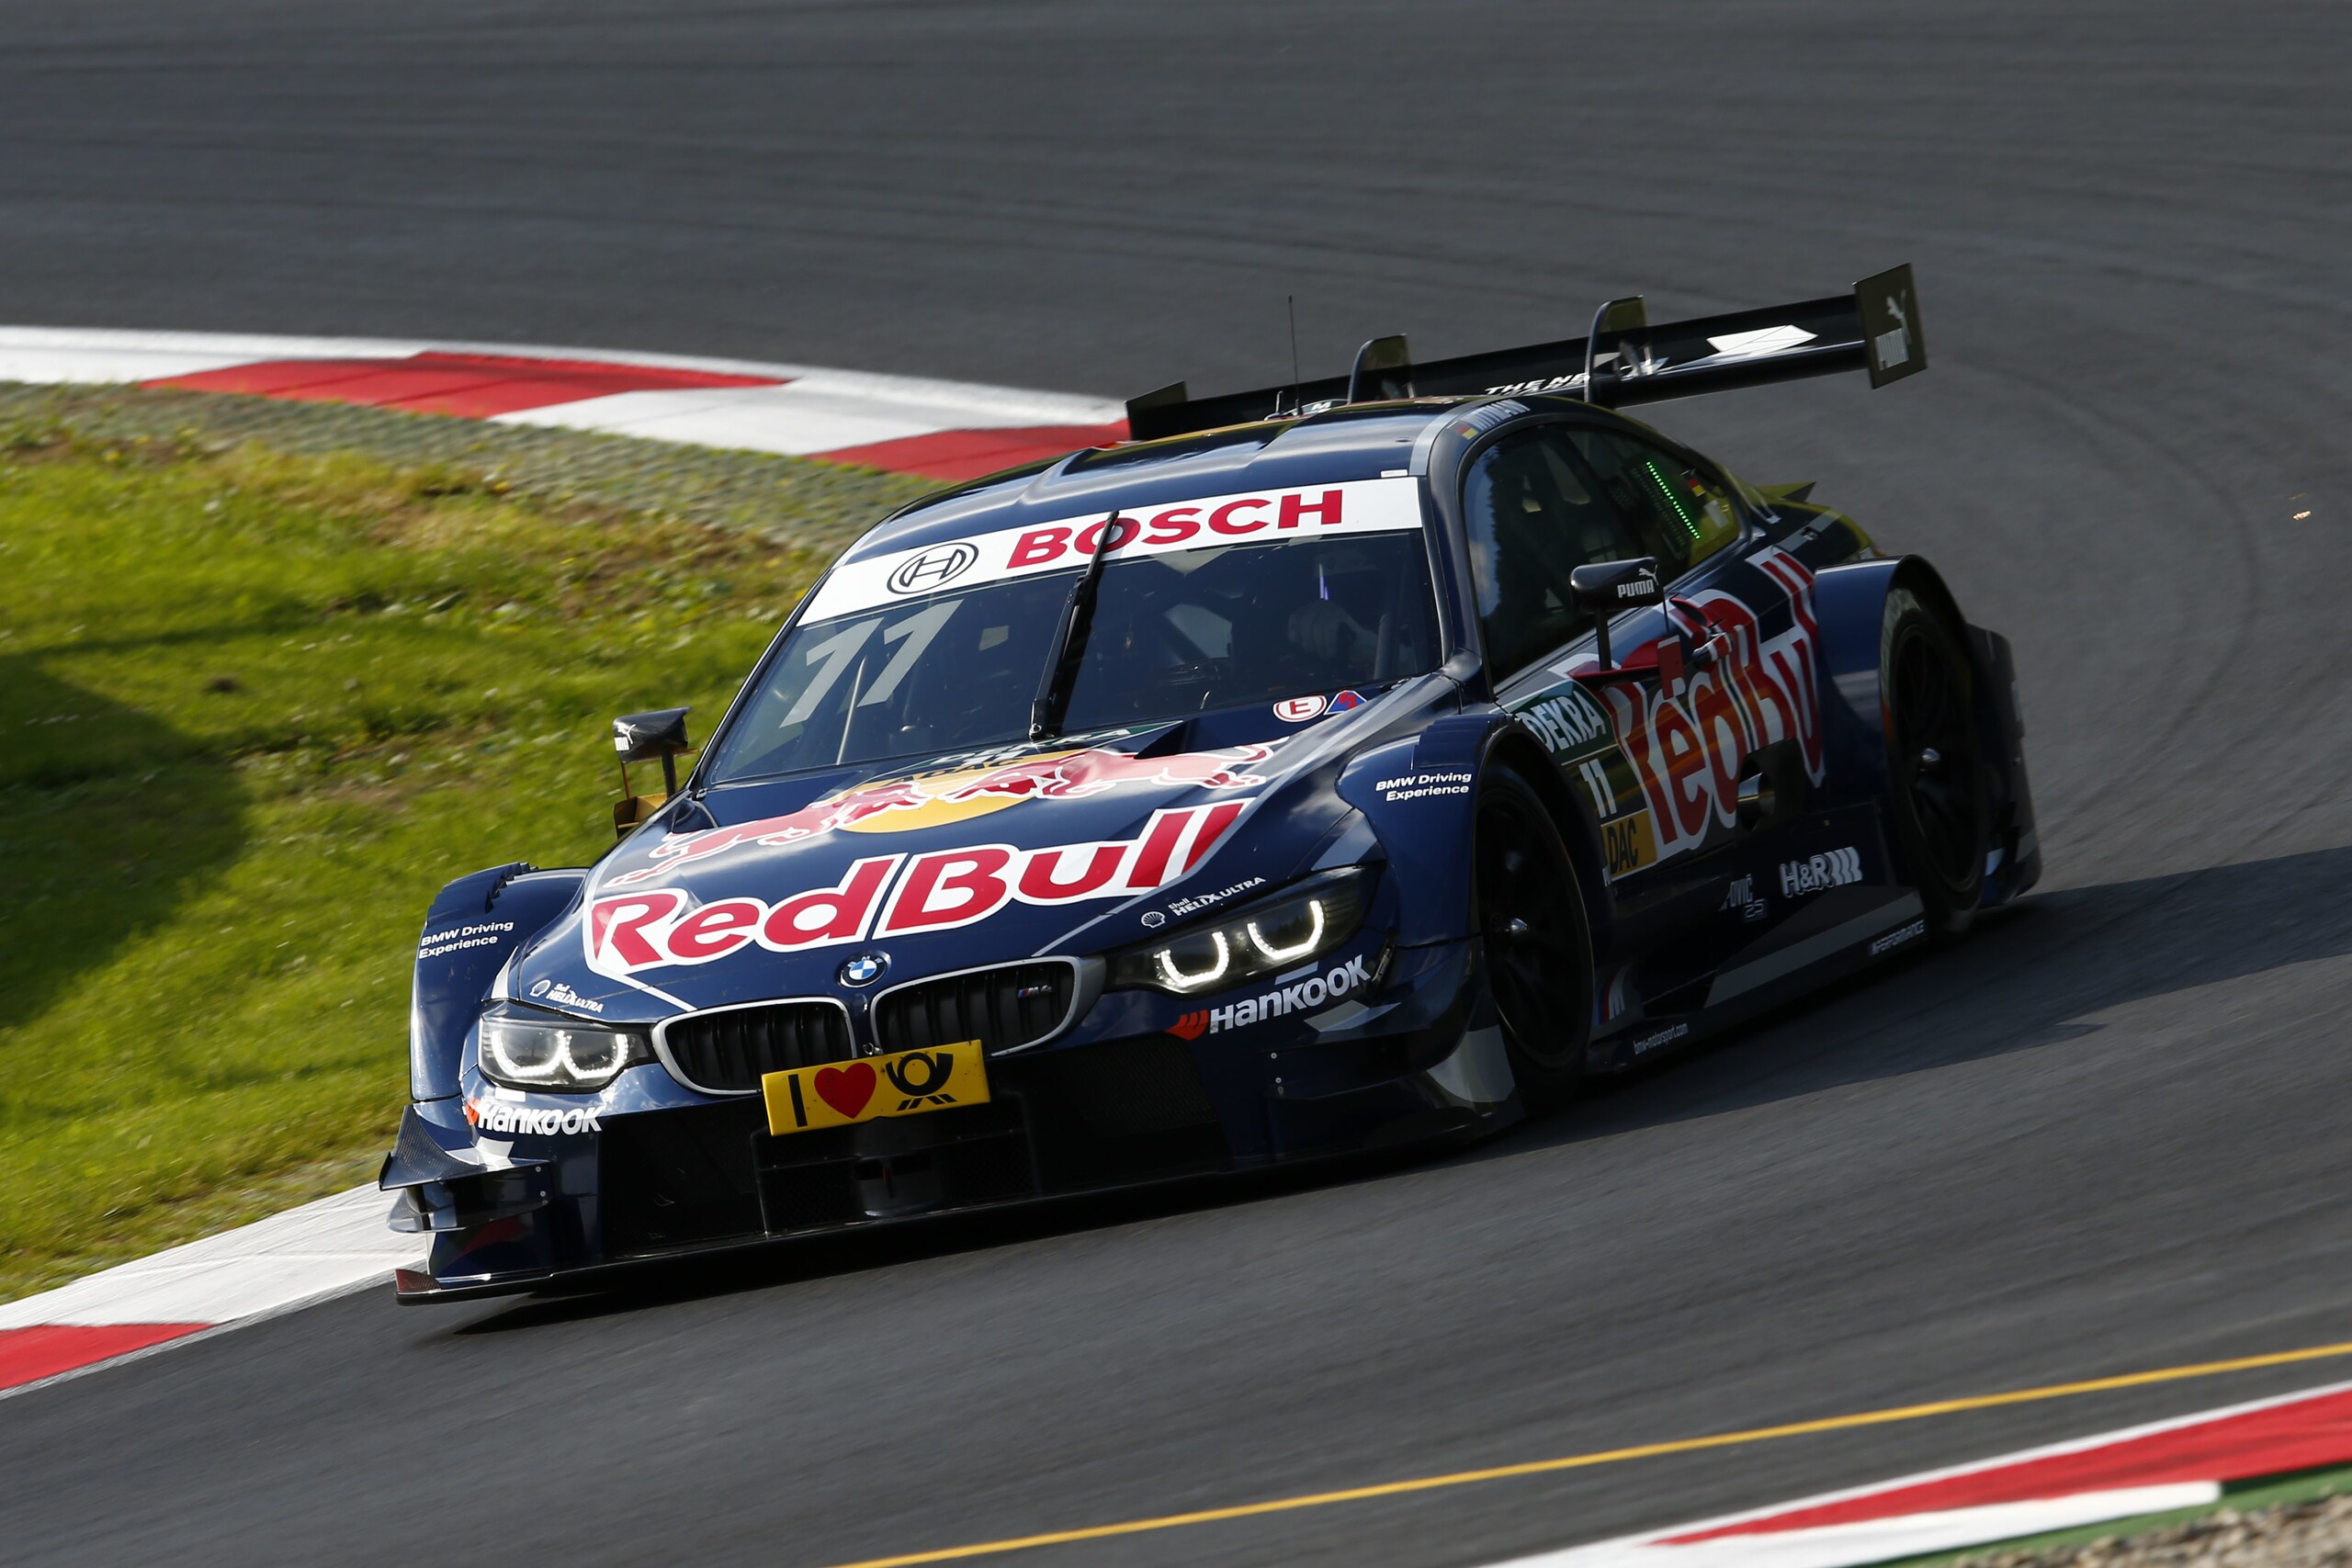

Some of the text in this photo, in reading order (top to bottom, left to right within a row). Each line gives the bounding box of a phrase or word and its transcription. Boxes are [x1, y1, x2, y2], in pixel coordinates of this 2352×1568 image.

[1007, 490, 1342, 570] BOSCH
[1617, 579, 1655, 599] PUMA
[779, 599, 965, 728] 11
[1289, 701, 1311, 716] E
[1515, 691, 1607, 754] DEKRA
[1375, 773, 1472, 792] BMW Driving
[1385, 785, 1469, 802] Experience
[1578, 758, 1617, 819] 11
[1604, 818, 1639, 874] DAC
[590, 798, 1250, 971] Red Bull
[1168, 897, 1190, 910] Shell
[1172, 876, 1266, 917] HELIX ULTRA
[419, 936, 498, 959] Experience
[421, 921, 514, 947] BMW Driving
[787, 1074, 808, 1128] I
